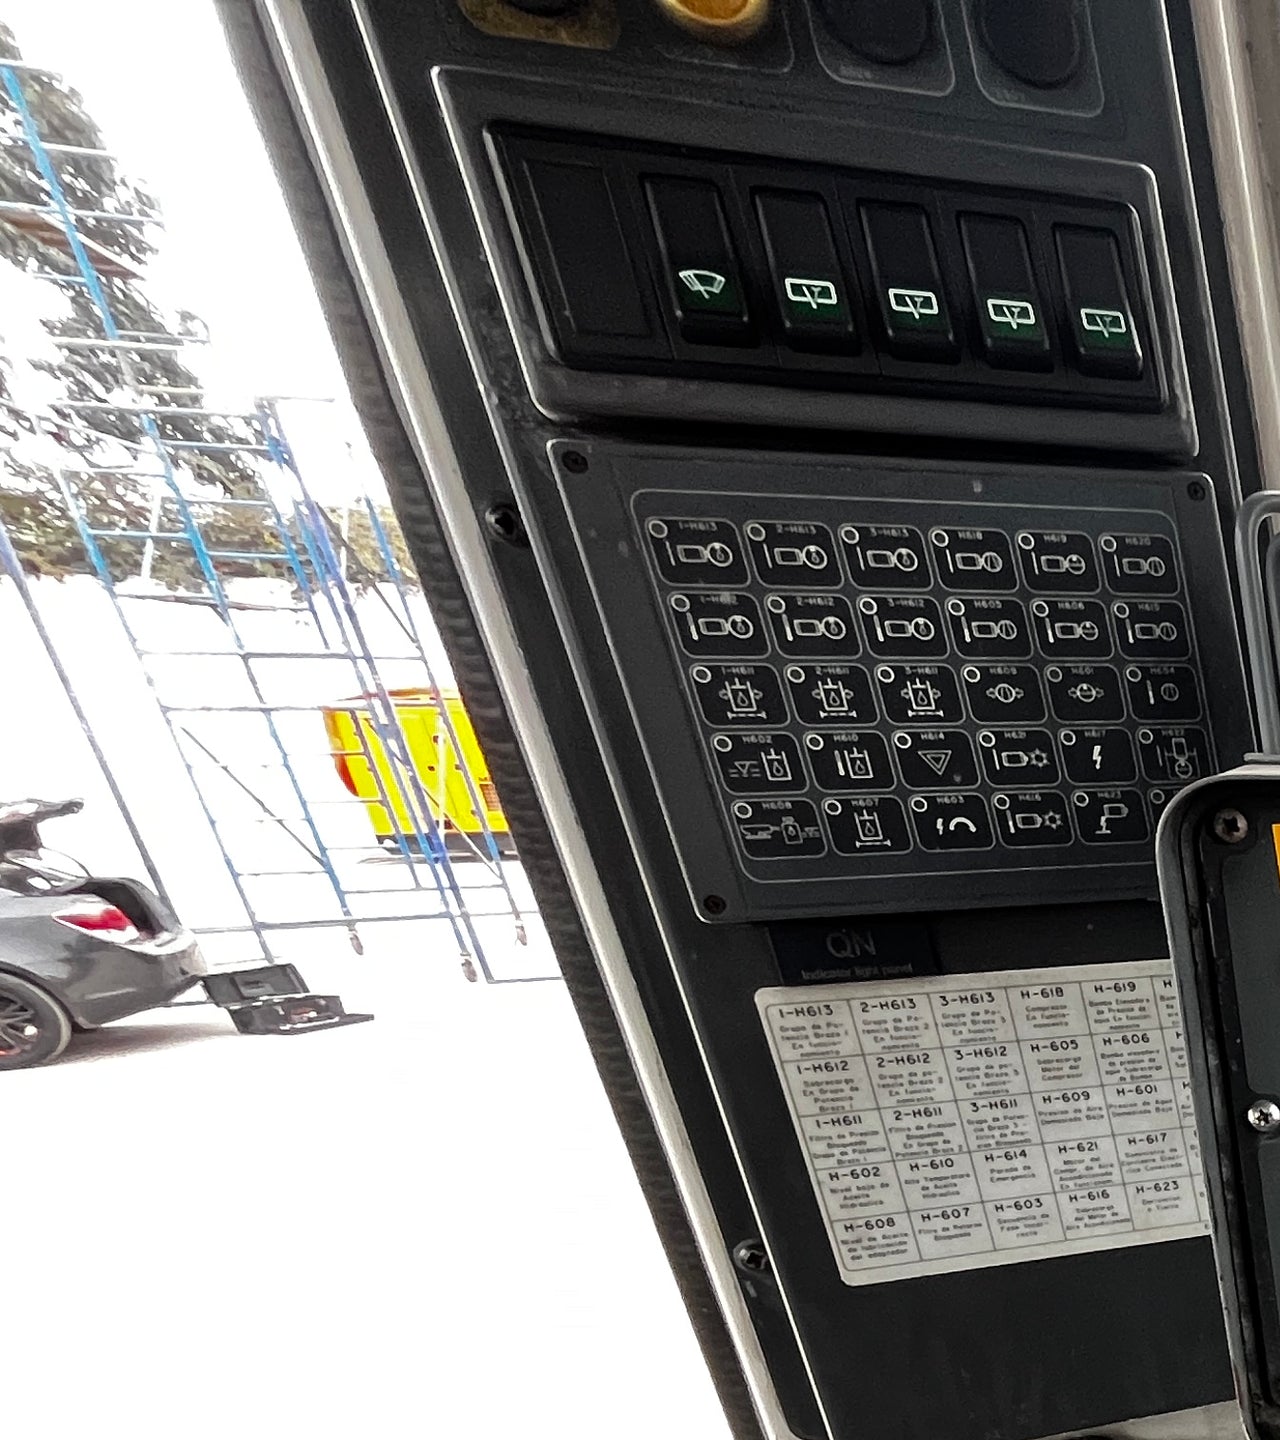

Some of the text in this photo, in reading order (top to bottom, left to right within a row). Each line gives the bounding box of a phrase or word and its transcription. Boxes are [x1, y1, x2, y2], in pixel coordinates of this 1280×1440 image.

[1021, 986, 1064, 999] H-618
[1094, 982, 1136, 994] H-619
[860, 999, 917, 1013] 2-H613
[940, 992, 995, 1006] 3-H613
[779, 1005, 833, 1018] 1-H613
[1030, 1039, 1079, 1053] H-605
[1103, 1033, 1150, 1047] H-606
[955, 1046, 1007, 1060] 3-H612
[797, 1060, 849, 1074] 1-H612
[876, 1053, 931, 1068] 2-H612
[1043, 1091, 1090, 1104] H-609
[1116, 1085, 1157, 1096] H-601
[970, 1099, 1018, 1113] 3-H611
[894, 1107, 942, 1120] 2-H611
[816, 1115, 862, 1128] 1-H611
[1128, 1133, 1167, 1145] H-617
[1058, 1141, 1099, 1154] H-621
[985, 1149, 1027, 1162] H-614
[910, 1158, 954, 1172] H-610
[829, 1167, 881, 1181] H-602
[1136, 1180, 1179, 1194] H-623
[1069, 1189, 1110, 1203] H-616
[994, 1198, 1043, 1213] H-603
[921, 1208, 970, 1222] H-607
[844, 1217, 896, 1233] H-608
